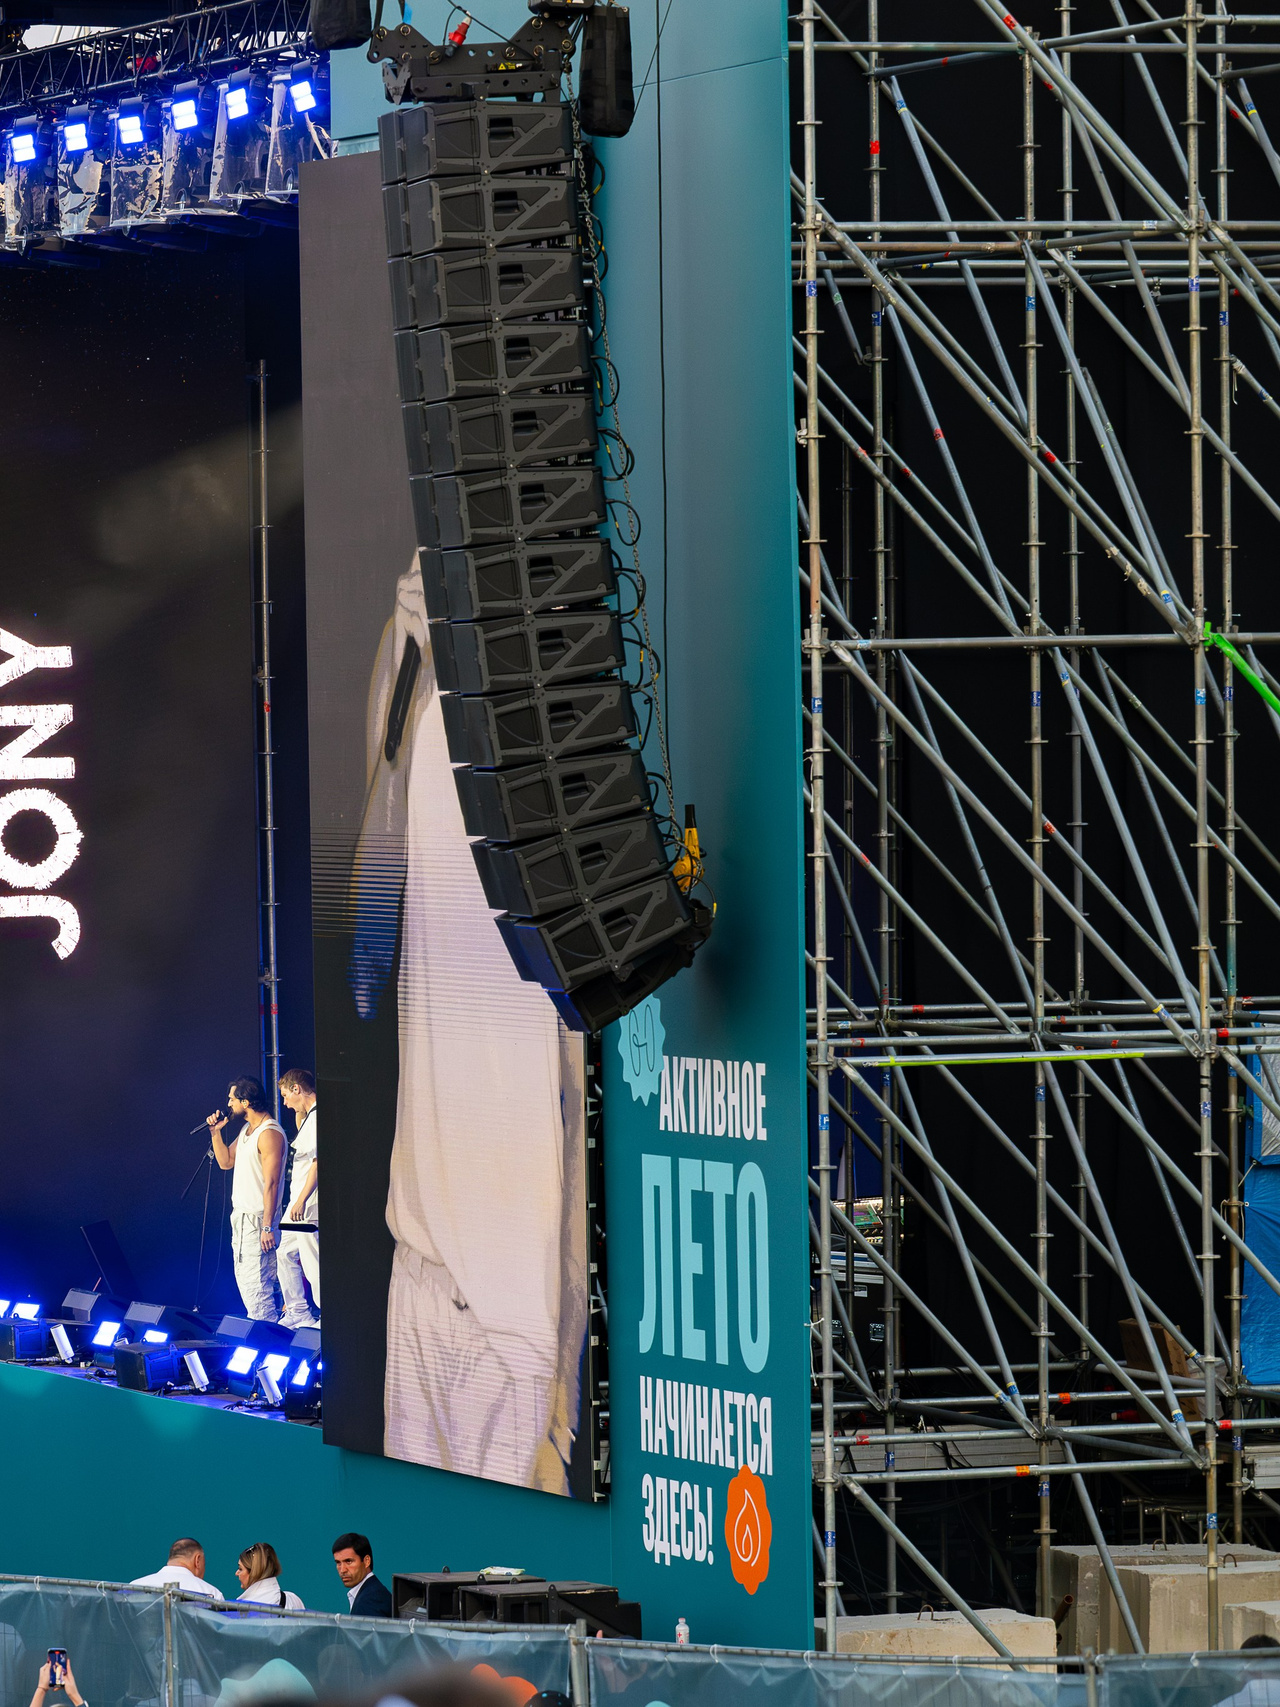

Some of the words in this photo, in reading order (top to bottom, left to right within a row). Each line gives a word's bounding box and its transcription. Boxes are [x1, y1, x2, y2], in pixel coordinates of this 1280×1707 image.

[659, 1055, 766, 1141] АКТИВНОЕ
[639, 1153, 771, 1374] ЛЕТО
[639, 1375, 773, 1477] НАЧИНАЕТСЯ
[641, 1473, 714, 1567] ЗДЕСЬ!
